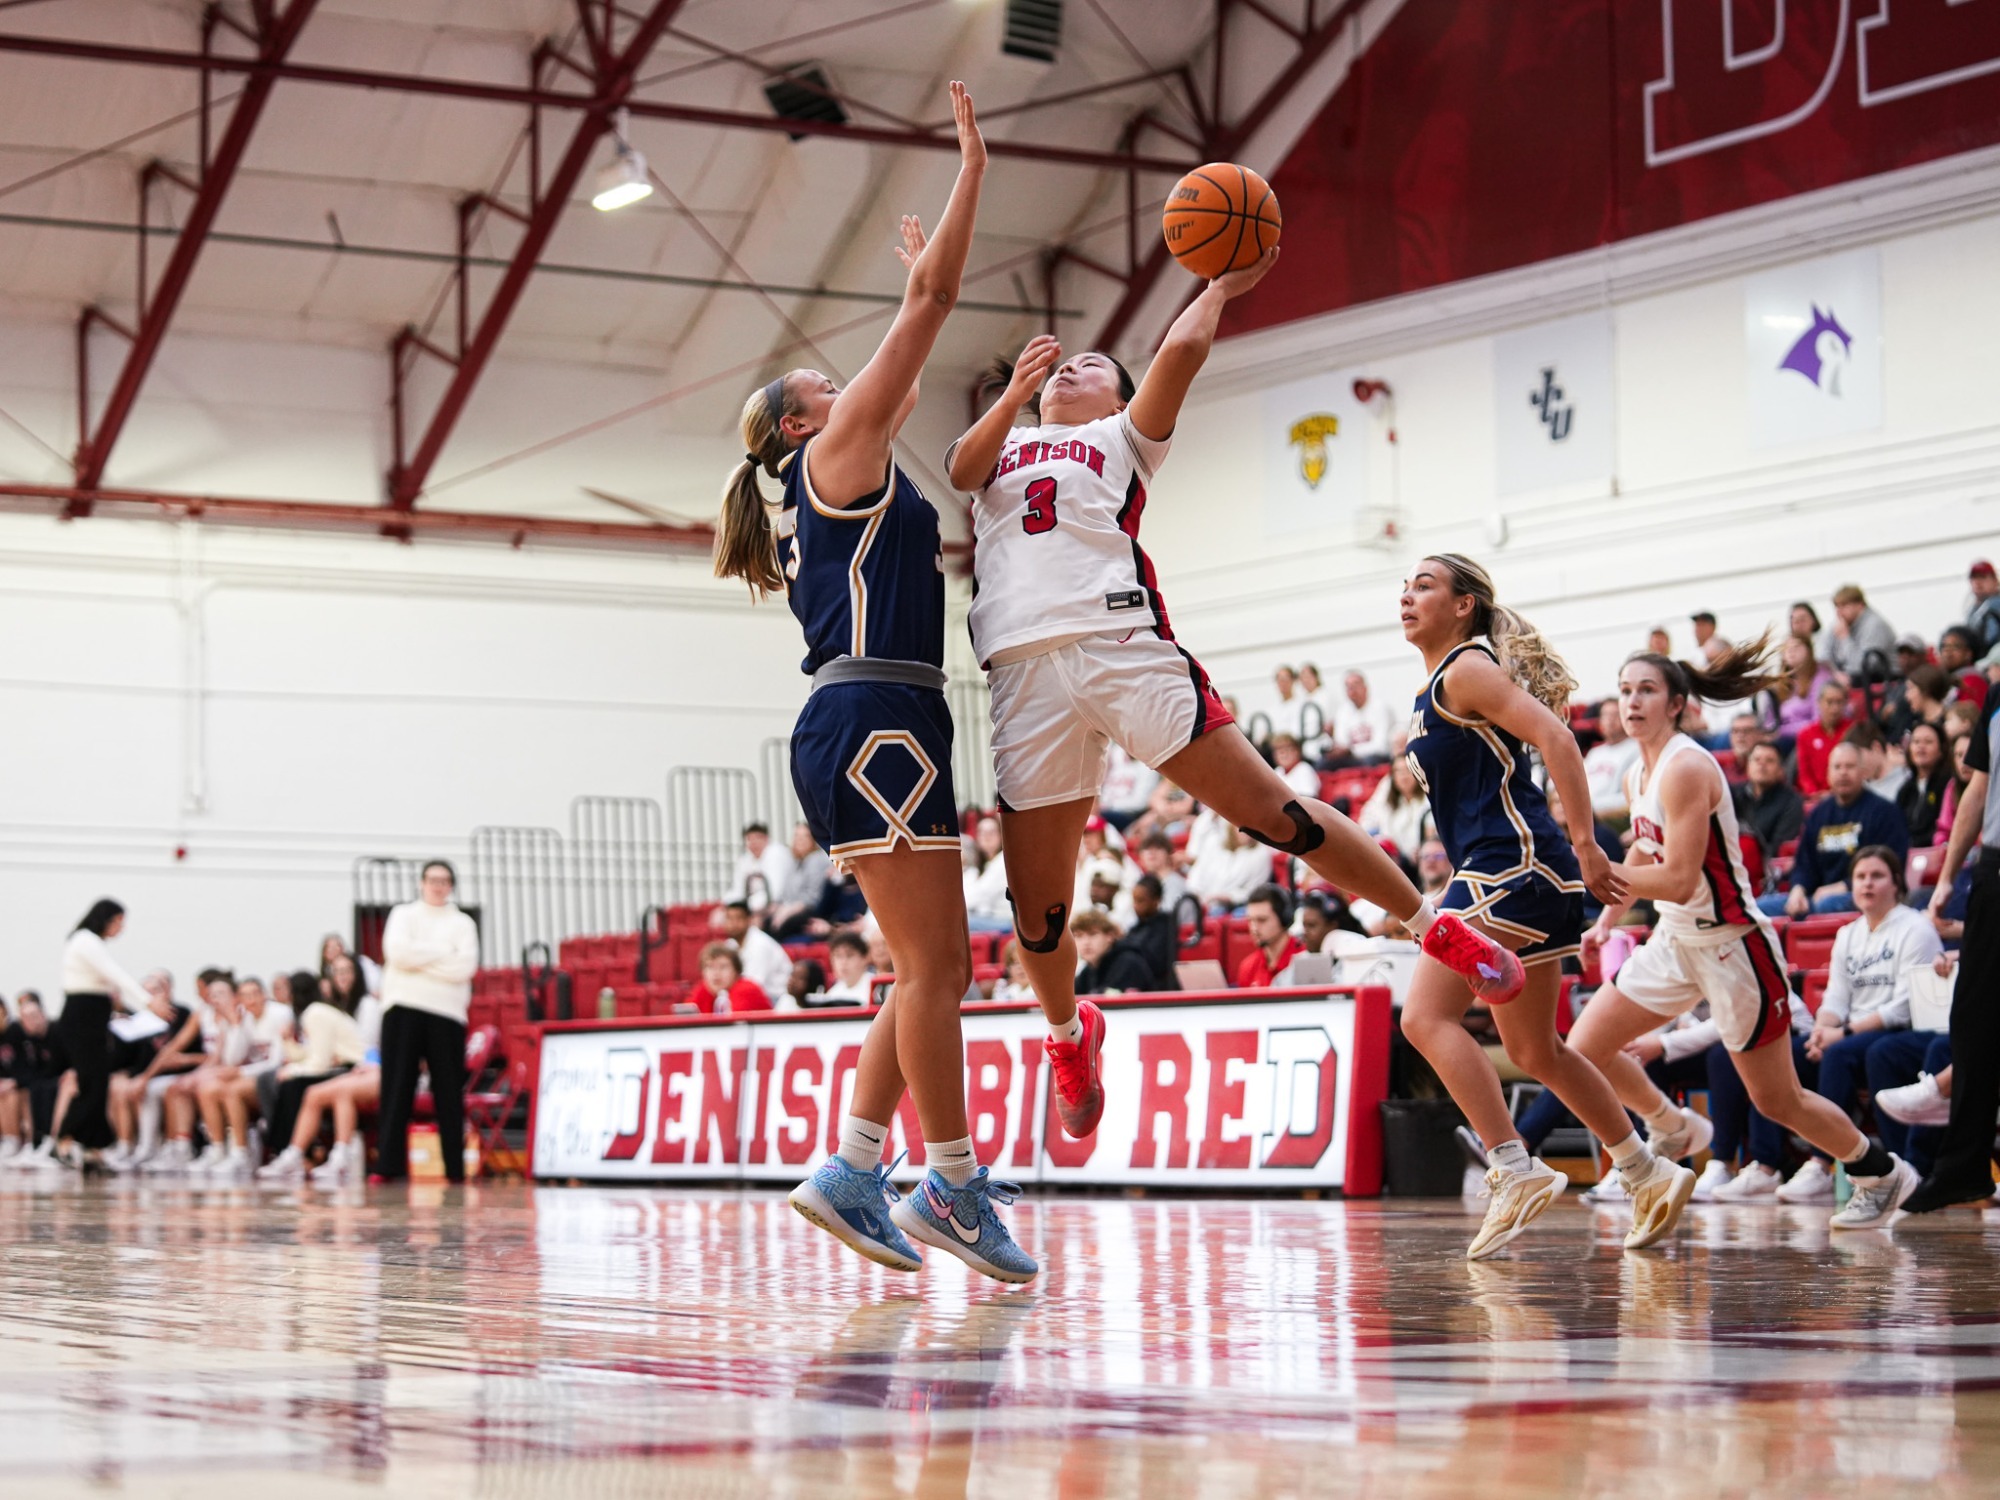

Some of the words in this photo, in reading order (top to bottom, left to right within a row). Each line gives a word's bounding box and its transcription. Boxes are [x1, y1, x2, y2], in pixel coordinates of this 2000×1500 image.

[983, 439, 1106, 492] ENISON
[1021, 476, 1058, 536] 3
[1132, 594, 1140, 603] M
[1129, 1026, 1338, 1169] RED
